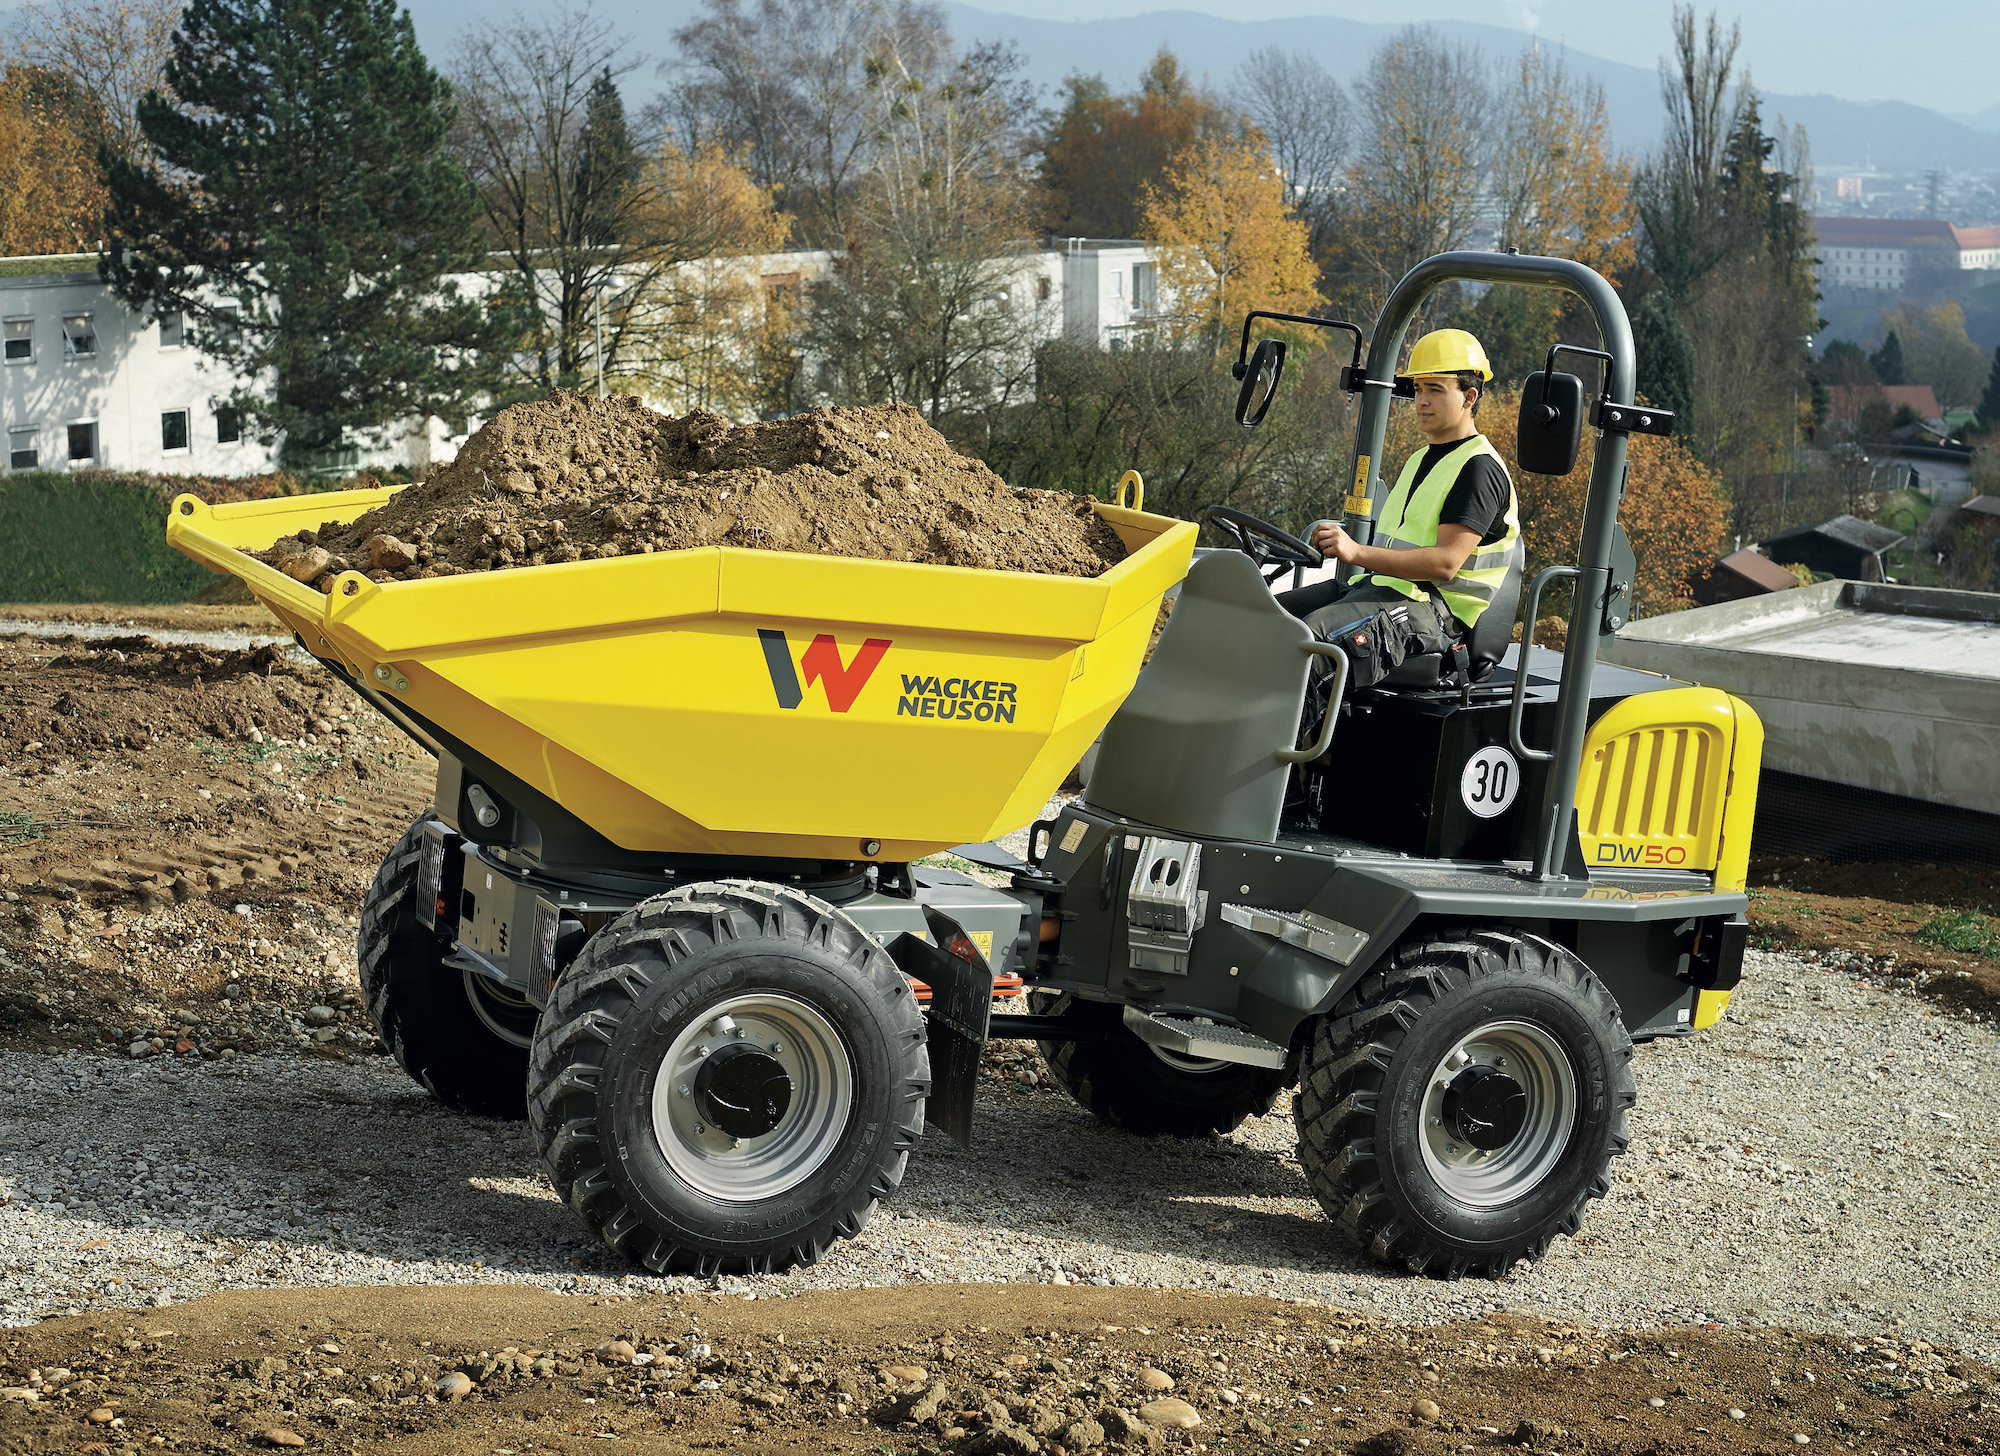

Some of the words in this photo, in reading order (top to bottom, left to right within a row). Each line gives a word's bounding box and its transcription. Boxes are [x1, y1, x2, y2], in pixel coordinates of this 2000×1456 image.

[900, 674, 1018, 703] WACKER
[897, 695, 1017, 724] NEUSON
[1471, 758, 1509, 803] 30
[1597, 843, 1686, 864] DW50
[658, 965, 733, 1022] MITAS
